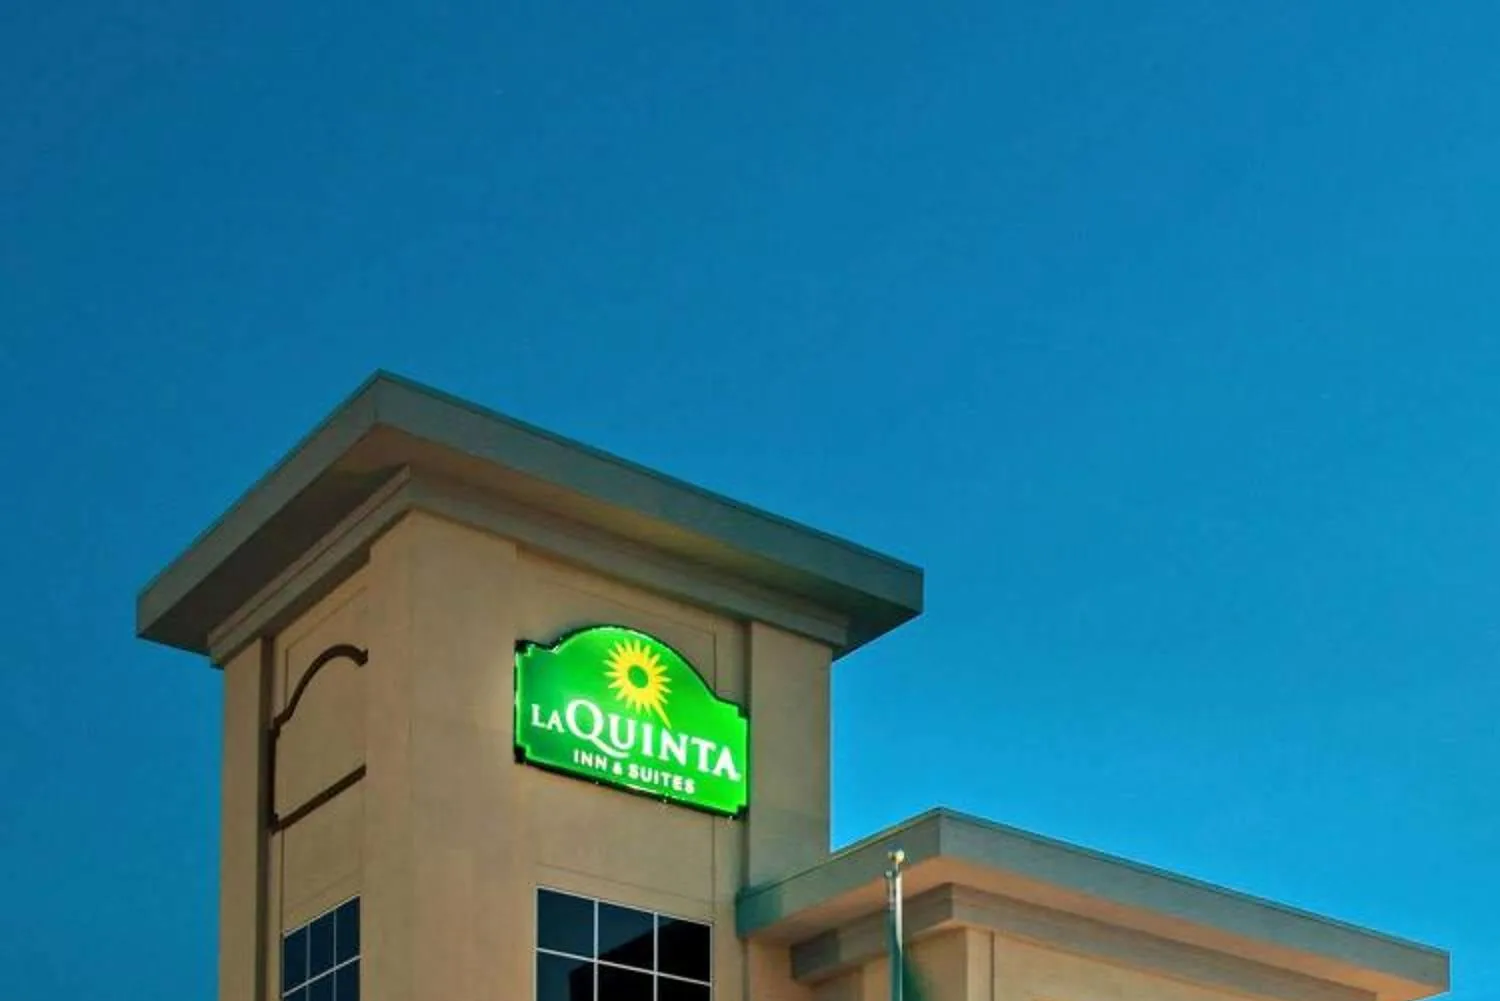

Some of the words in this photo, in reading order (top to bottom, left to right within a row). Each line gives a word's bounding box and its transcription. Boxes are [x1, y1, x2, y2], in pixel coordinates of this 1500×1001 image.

[573, 748, 608, 771] INN
[612, 761, 623, 776] &
[628, 763, 696, 795] SUITES
